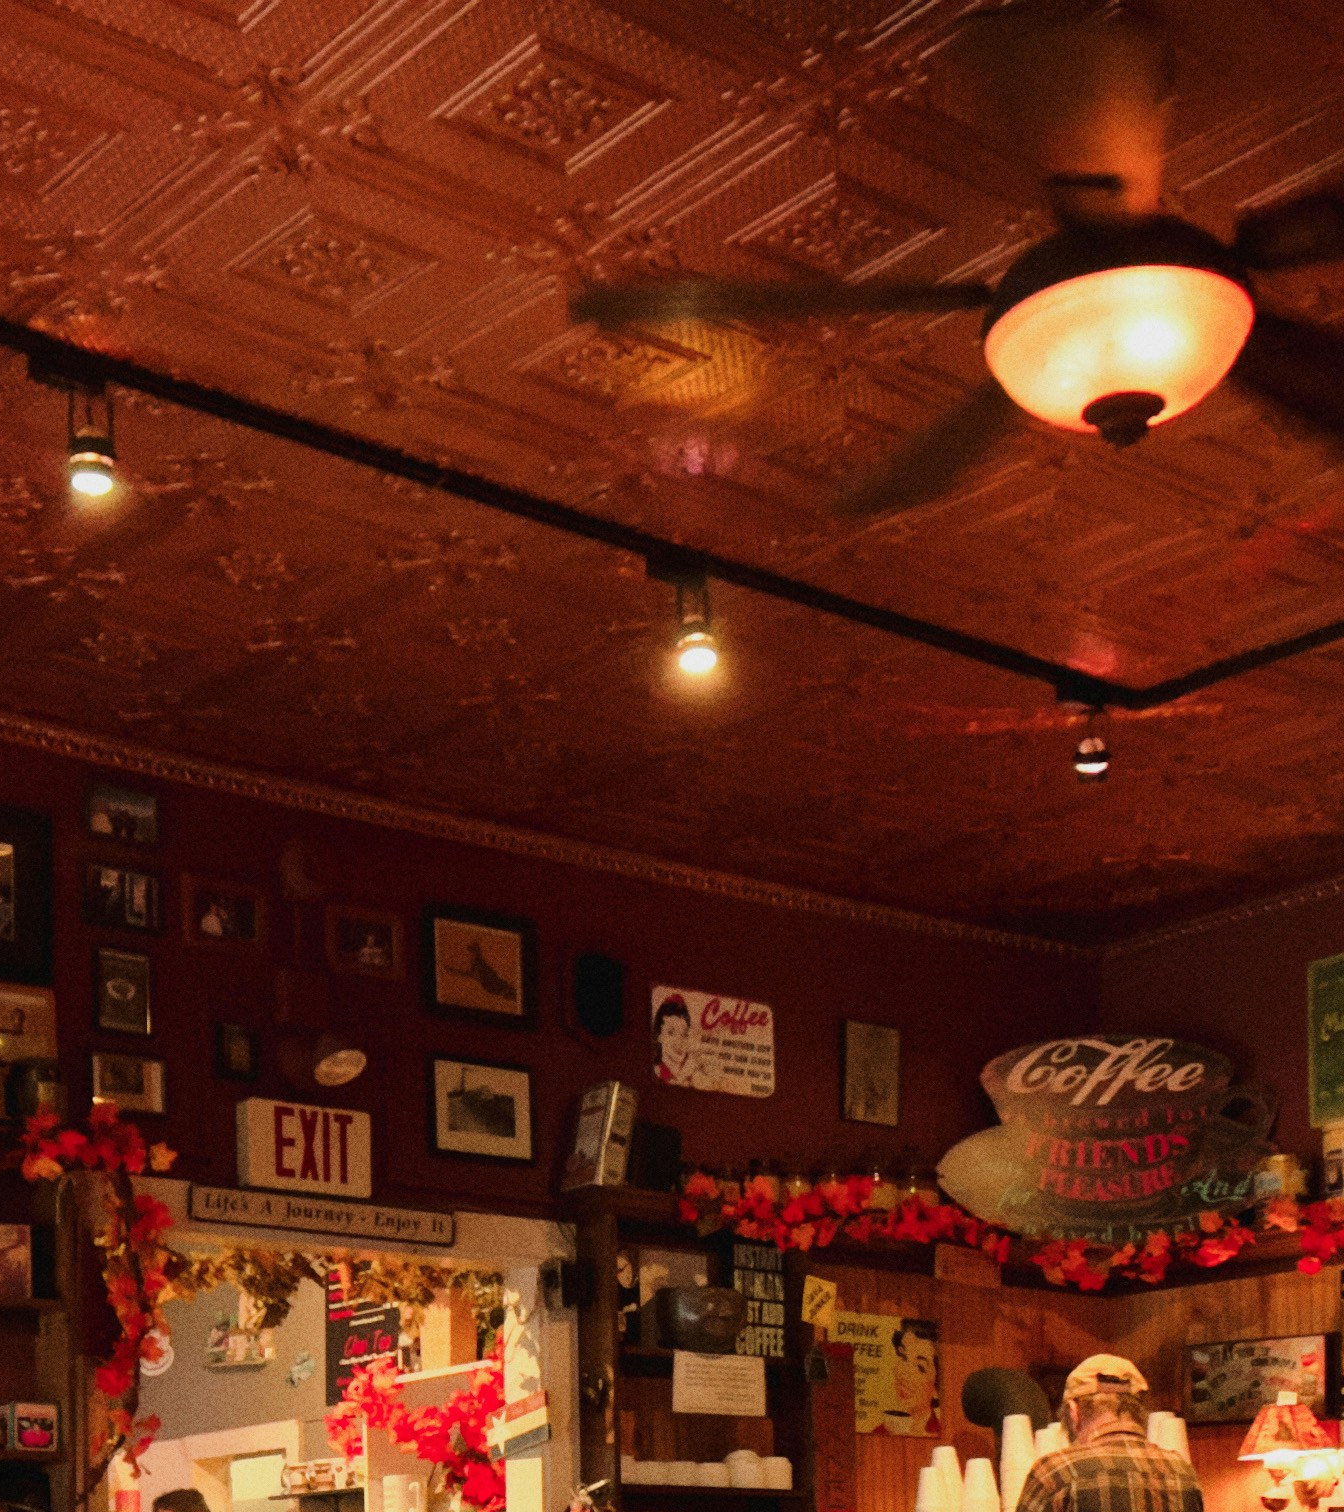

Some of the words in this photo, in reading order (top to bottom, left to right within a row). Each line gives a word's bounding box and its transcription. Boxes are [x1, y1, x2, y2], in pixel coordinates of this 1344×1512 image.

[701, 997, 770, 1035] Coffee
[1005, 1037, 1206, 1107] Coffee
[1044, 1107, 1150, 1130] brewed
[274, 1105, 353, 1185] EXIT
[1026, 1132, 1190, 1169] FRIENDS
[1038, 1163, 1175, 1202] PLEASURE
[1181, 1168, 1254, 1203] And
[204, 1192, 249, 1212] Life's
[260, 1200, 273, 1212] A
[285, 1201, 354, 1223] Journey
[374, 1212, 421, 1233] Enjoy
[735, 1325, 785, 1358] COFFEE
[837, 1322, 880, 1338] DRINK
